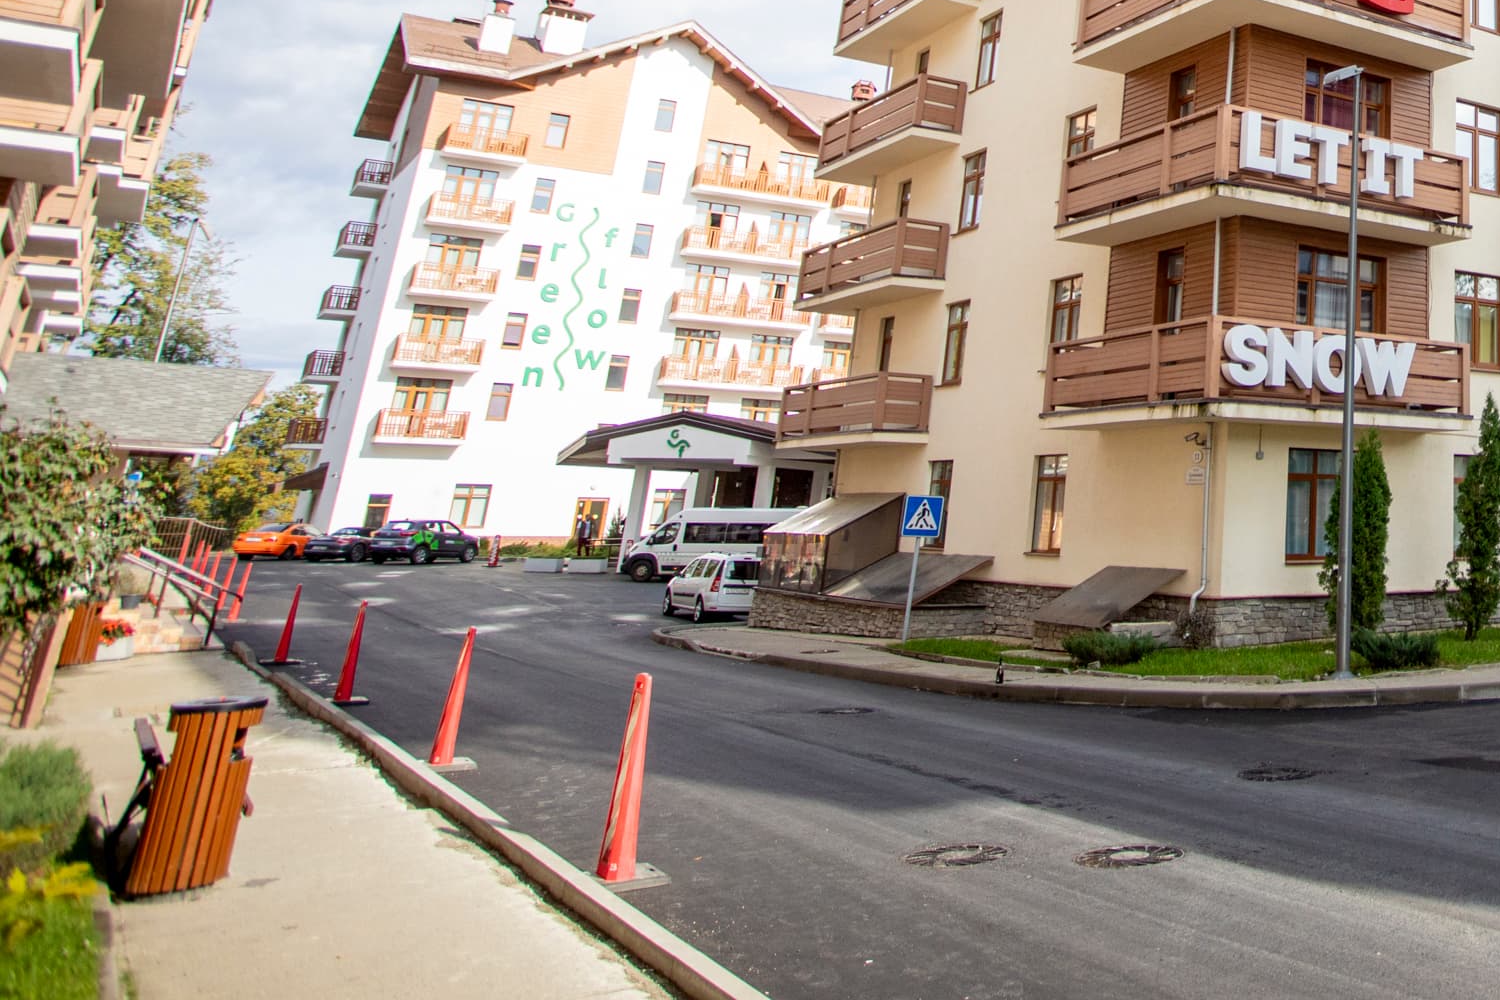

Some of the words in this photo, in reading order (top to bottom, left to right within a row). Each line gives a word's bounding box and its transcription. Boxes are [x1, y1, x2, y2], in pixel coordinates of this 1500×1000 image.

[1239, 110, 1350, 185] LET
[1360, 138, 1424, 199] IT
[1220, 324, 1417, 398] SNOW
